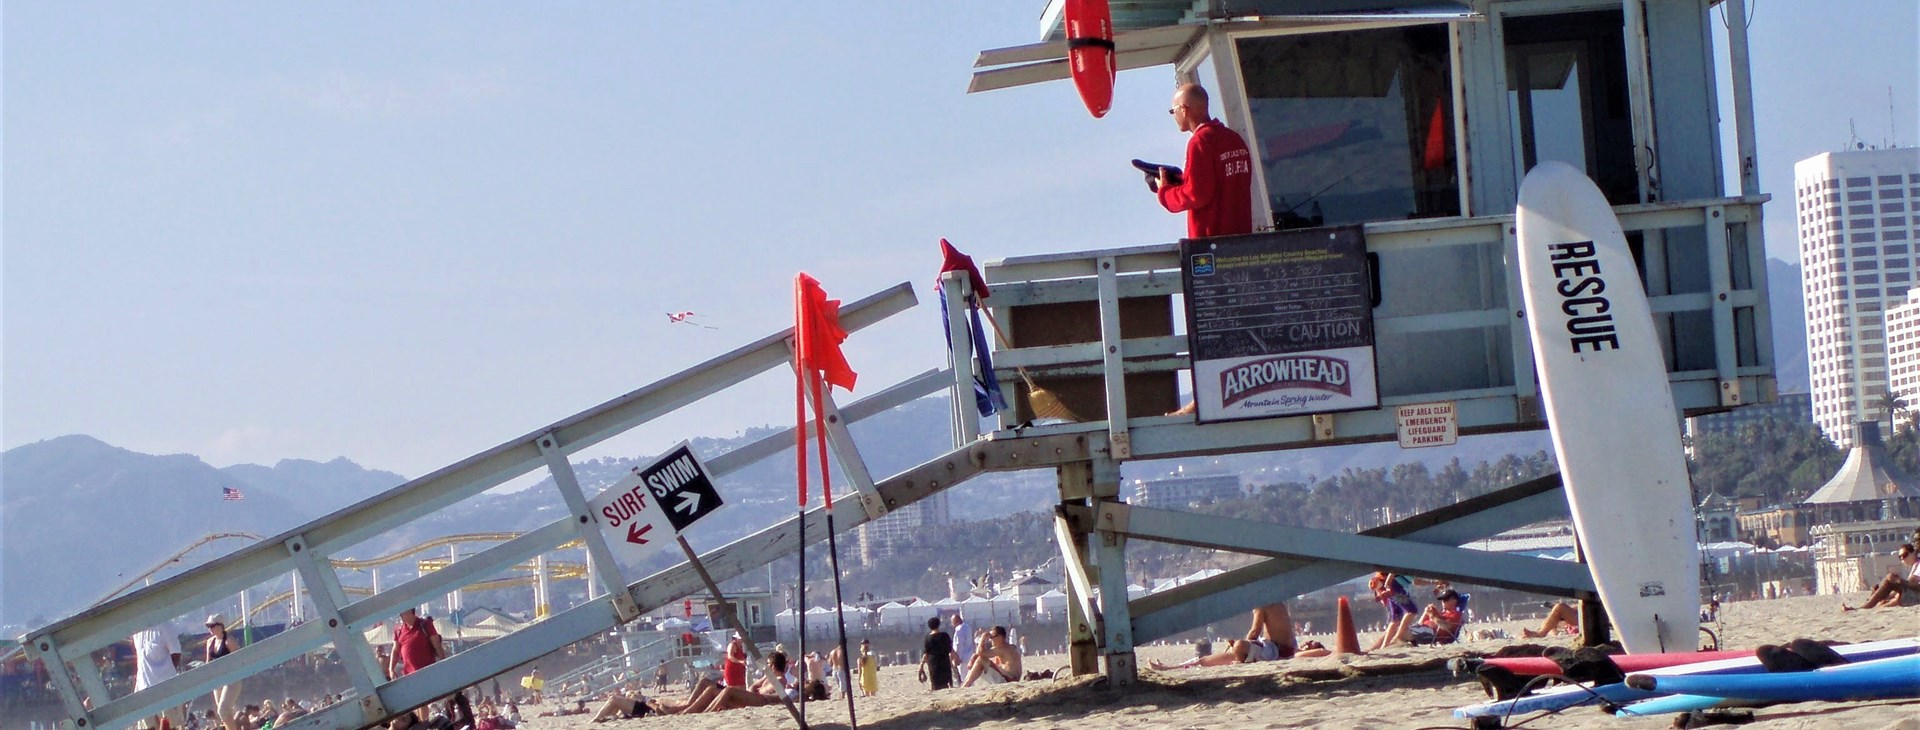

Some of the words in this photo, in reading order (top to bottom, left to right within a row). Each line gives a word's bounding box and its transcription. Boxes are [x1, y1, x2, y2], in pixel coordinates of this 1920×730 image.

[1216, 256, 1241, 264] Welcome
[1260, 252, 1282, 262] Angeles
[1283, 250, 1304, 259] County
[1547, 240, 1620, 354] RESCUE
[1288, 321, 1361, 342] CAUTION
[1224, 358, 1347, 400] ARROWHEAD
[1240, 398, 1280, 409] Mountain
[1280, 394, 1307, 407] Spring
[1400, 408, 1415, 417] KEEP
[1416, 407, 1432, 416] AREA
[1433, 406, 1452, 415] CLEAR
[1405, 416, 1447, 427] EMERGENCY
[1408, 425, 1447, 435] LIFEGUARD
[1412, 434, 1444, 444] PARKING
[647, 455, 699, 498] SWIM
[602, 485, 647, 528] SURF
